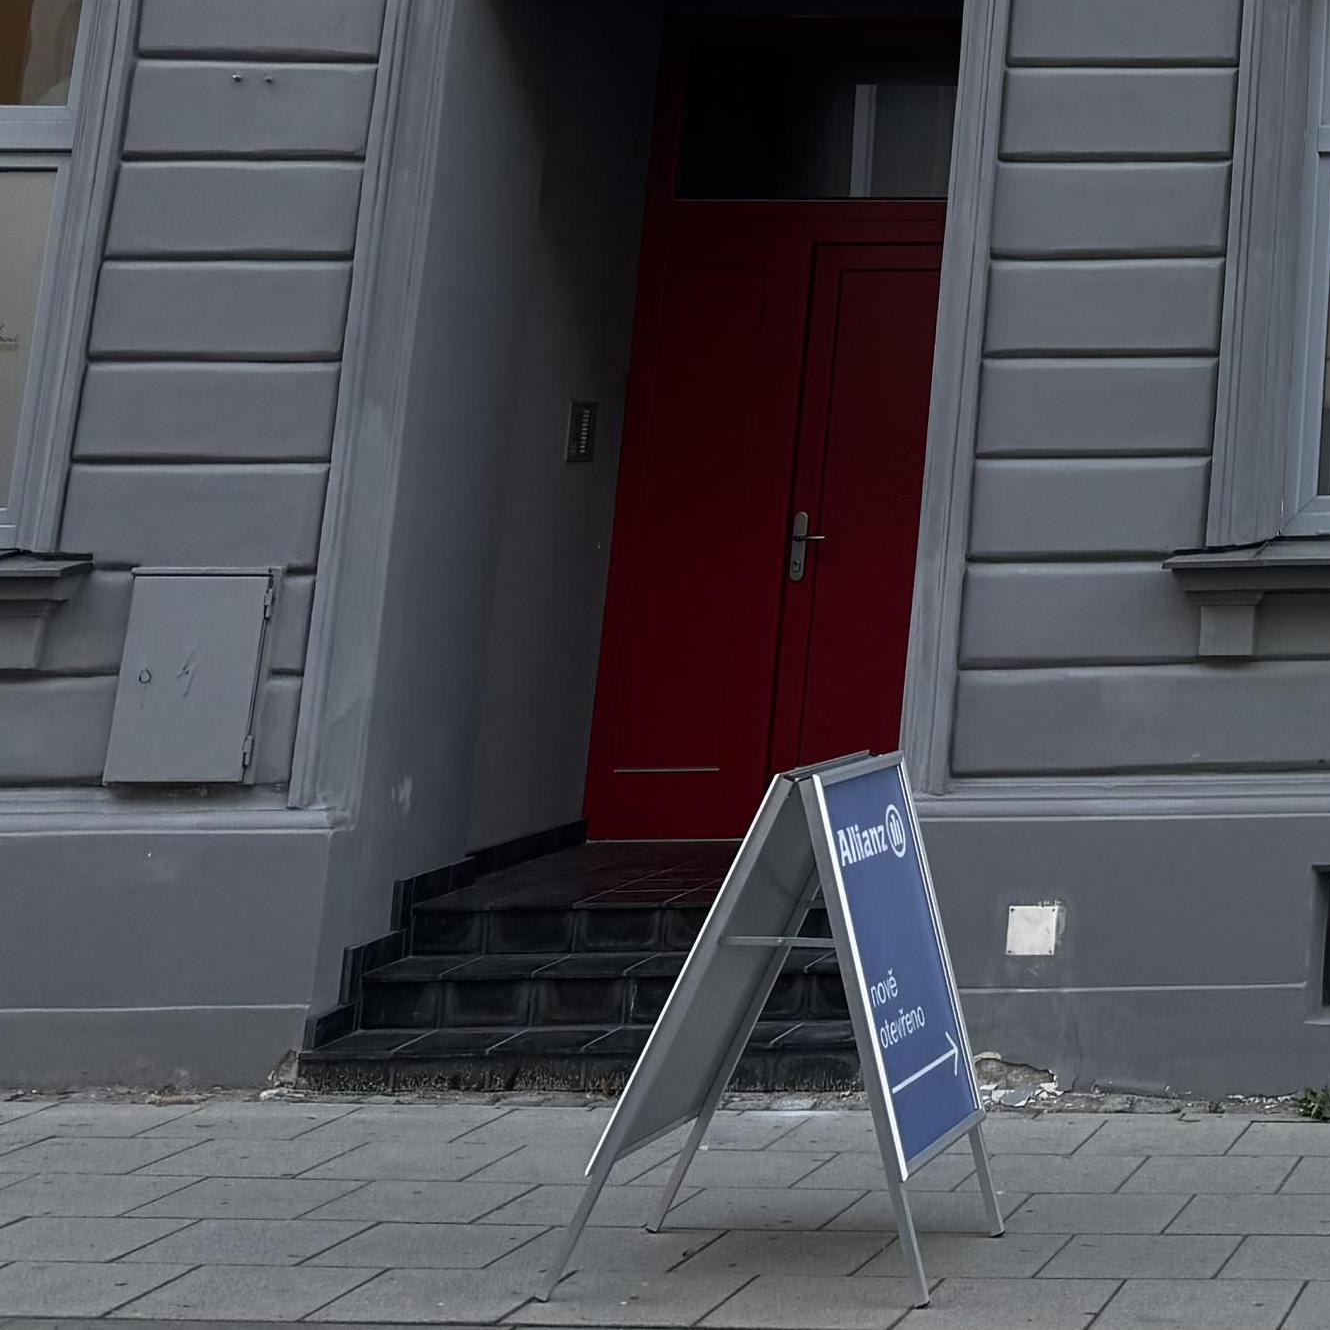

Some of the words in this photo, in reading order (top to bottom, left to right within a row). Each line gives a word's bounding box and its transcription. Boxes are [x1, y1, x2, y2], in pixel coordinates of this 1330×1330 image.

[837, 823, 889, 867] Allianz
[870, 968, 898, 1008] nově
[880, 1005, 925, 1049] otevřeno
